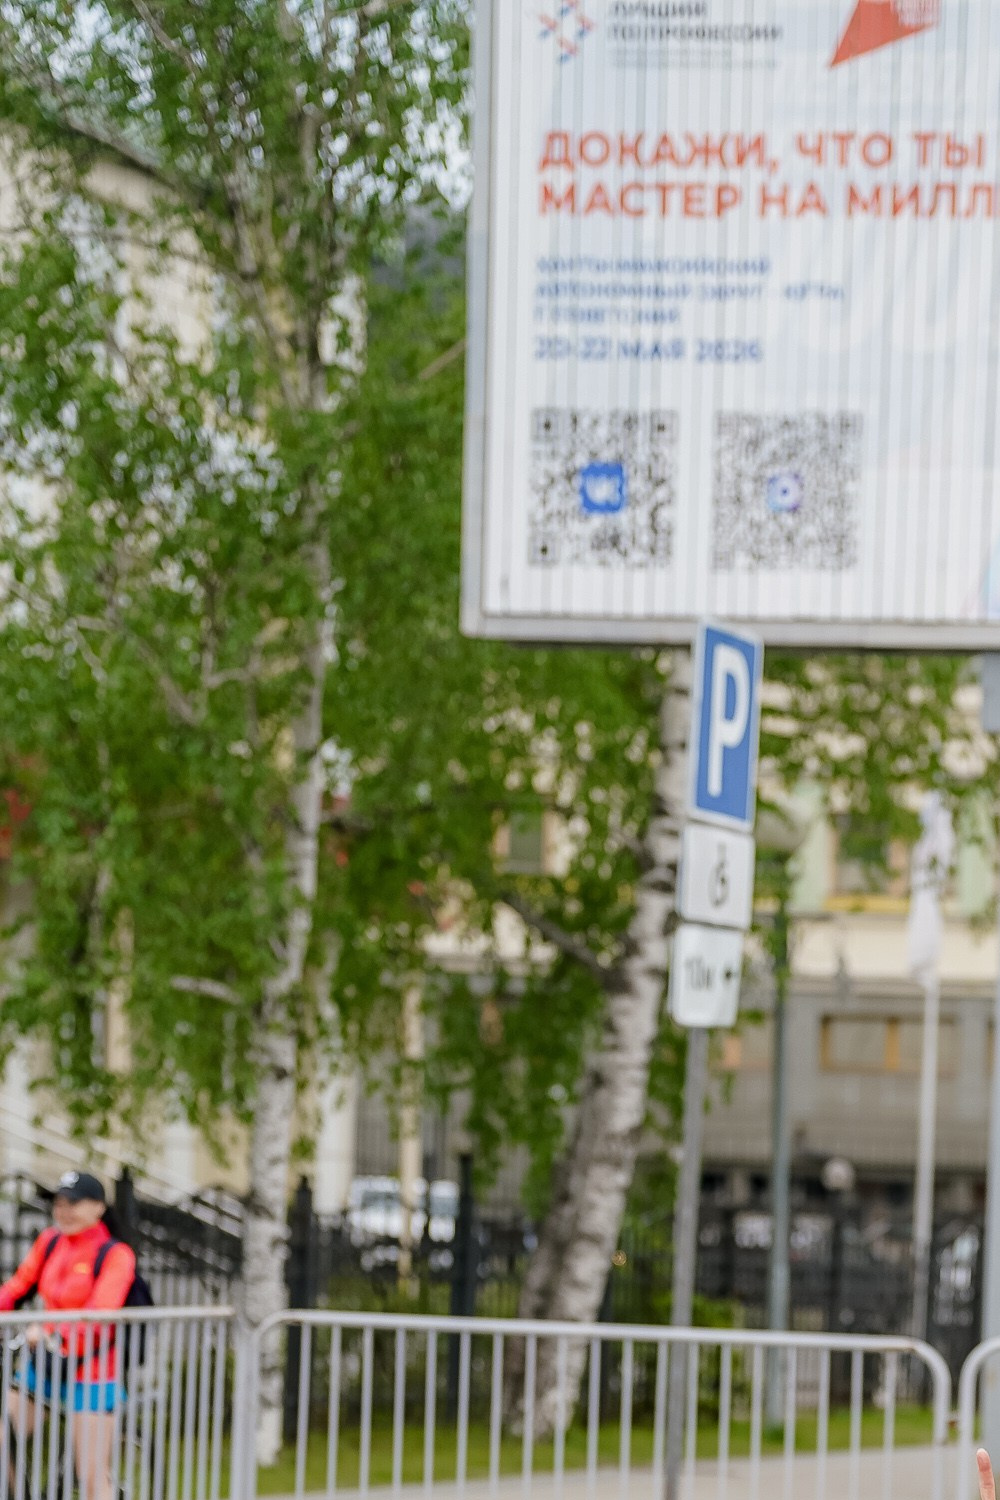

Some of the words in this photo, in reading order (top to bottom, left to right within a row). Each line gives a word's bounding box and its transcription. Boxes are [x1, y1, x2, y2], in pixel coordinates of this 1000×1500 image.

[539, 131, 779, 174] ДОКАЖИ,
[796, 131, 893, 169] ЧТО
[913, 131, 985, 169] ТЫ
[539, 182, 741, 217] МАСТЕР
[759, 182, 827, 217] НА
[707, 643, 750, 797] P
